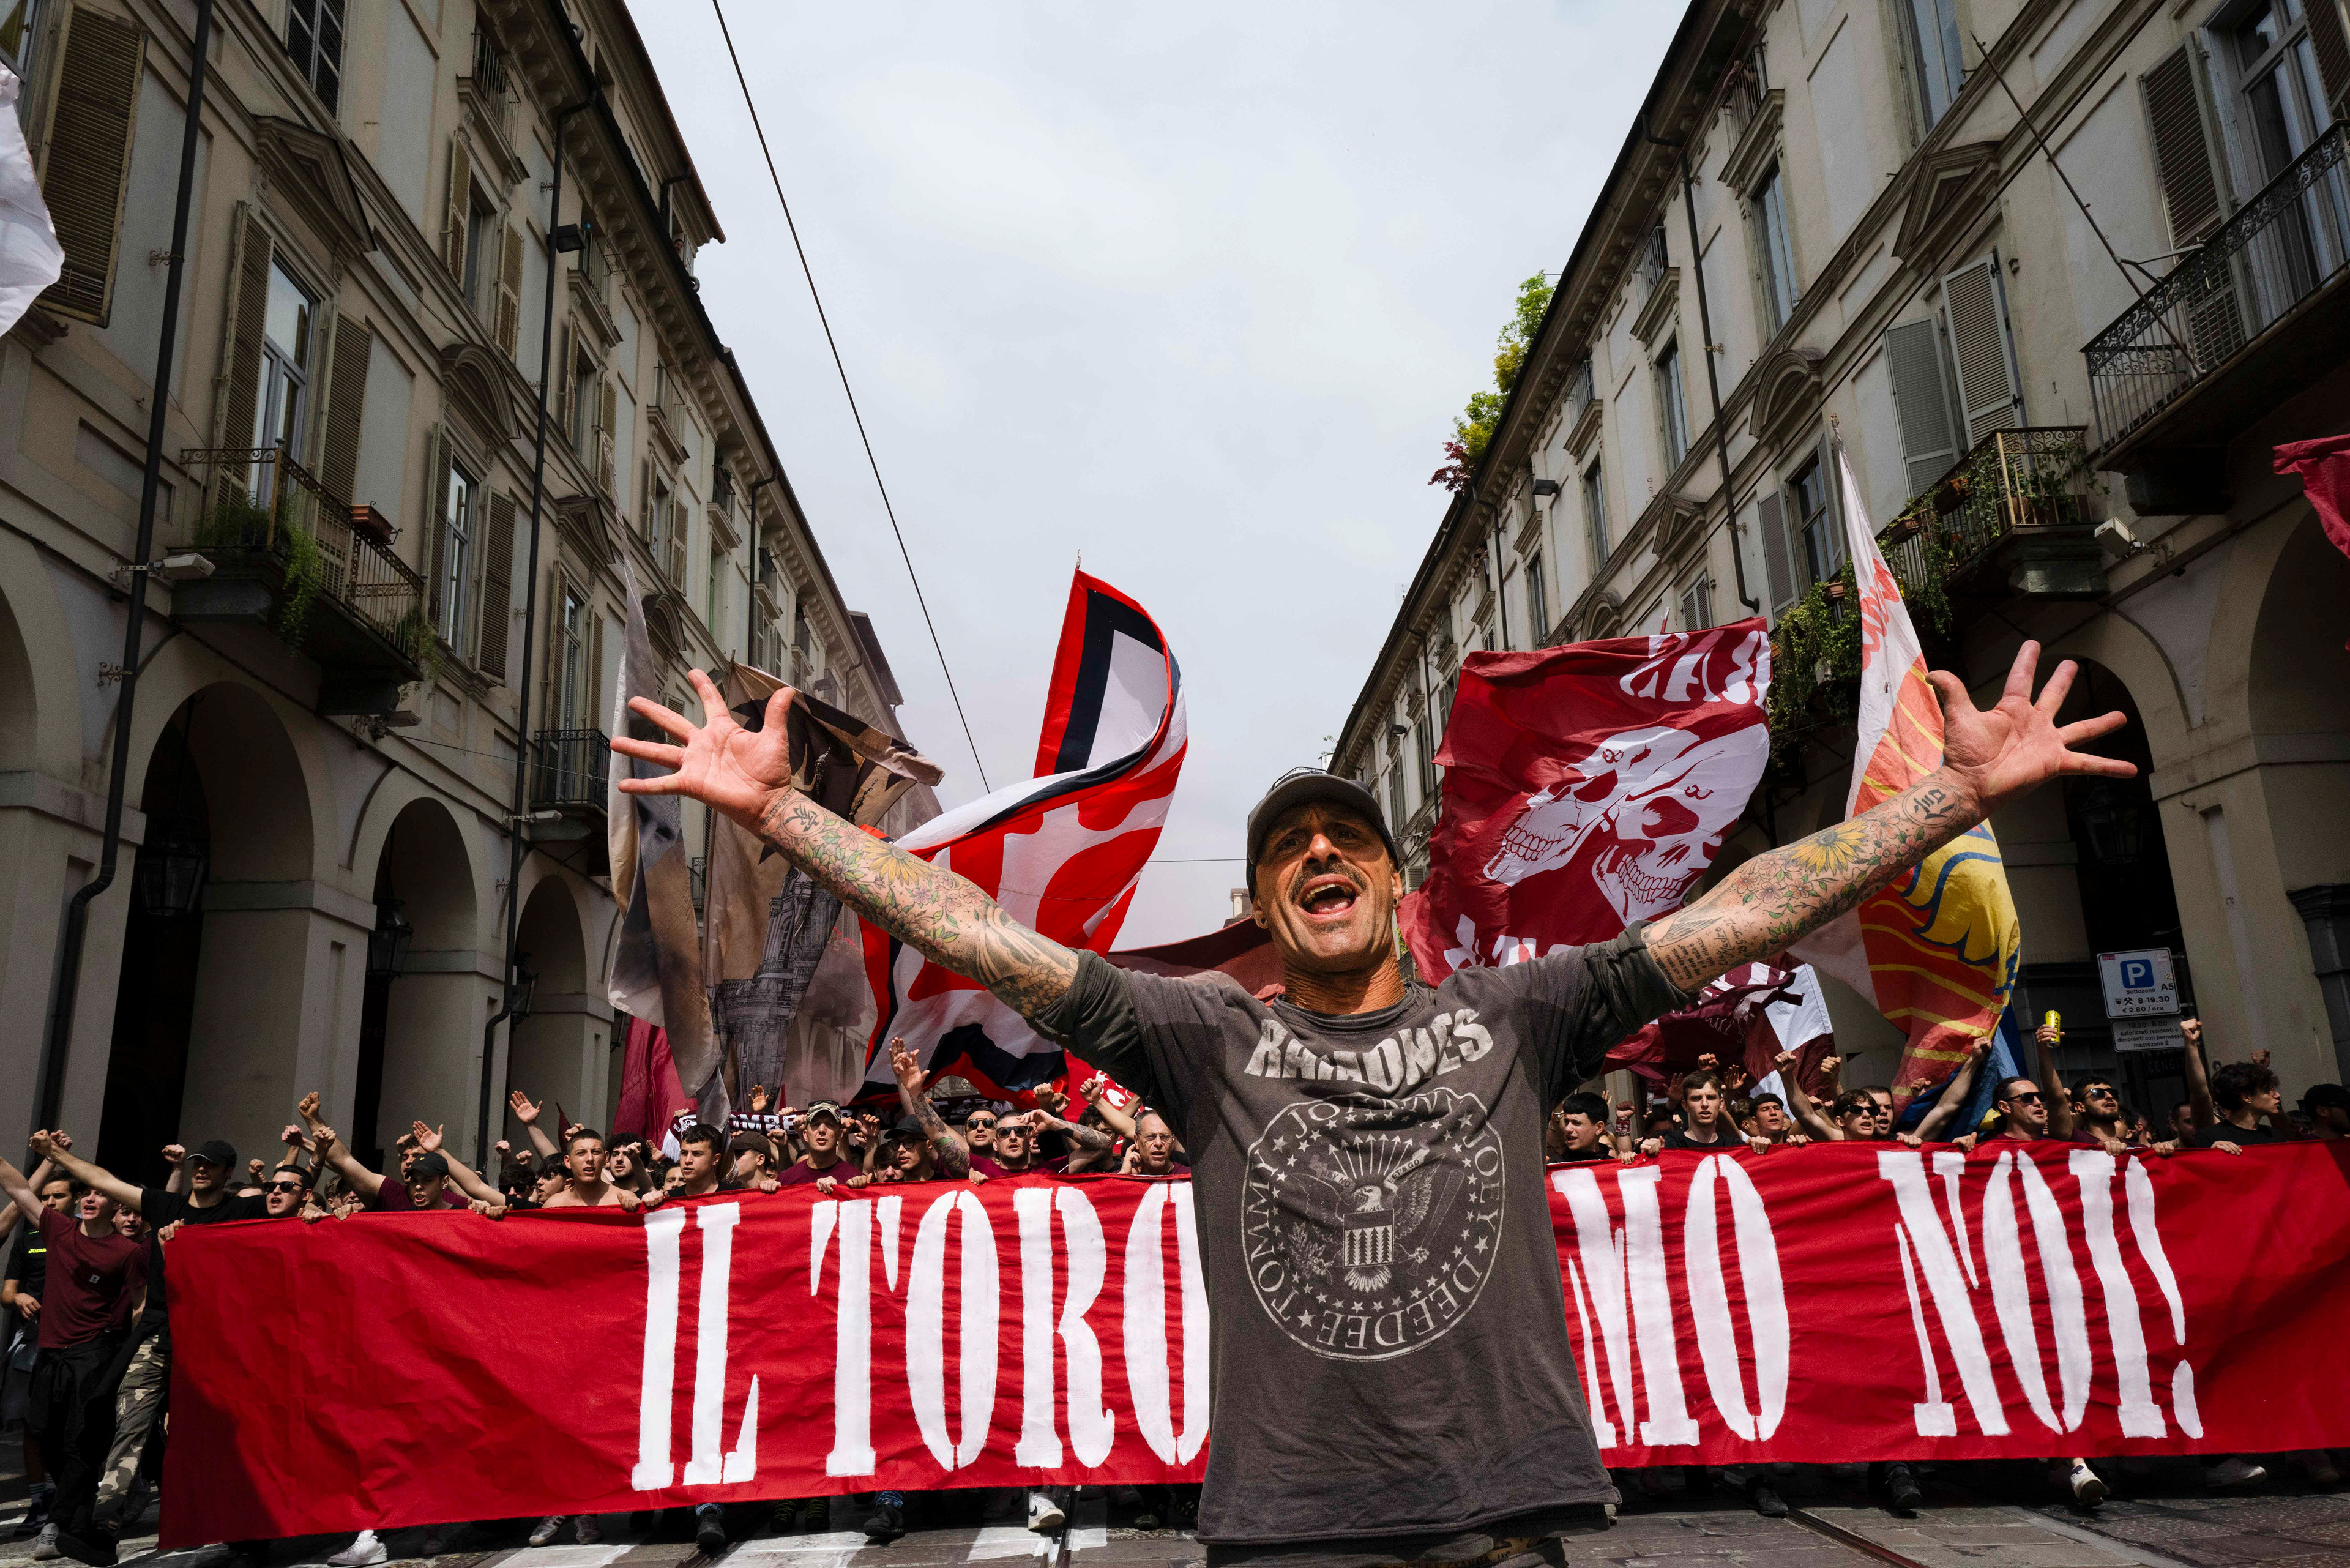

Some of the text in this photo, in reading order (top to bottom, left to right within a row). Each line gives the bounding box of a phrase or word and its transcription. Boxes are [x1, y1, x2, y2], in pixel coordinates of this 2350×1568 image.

[2127, 963, 2146, 985] P
[1387, 1159, 1420, 1184] LET'S GO
[1462, 1129, 1501, 1233] JOEY
[1247, 1149, 1300, 1323] TOMMY
[631, 1201, 761, 1491] IL
[810, 1181, 1210, 1477] TORO
[1877, 1148, 2204, 1439] NOI!
